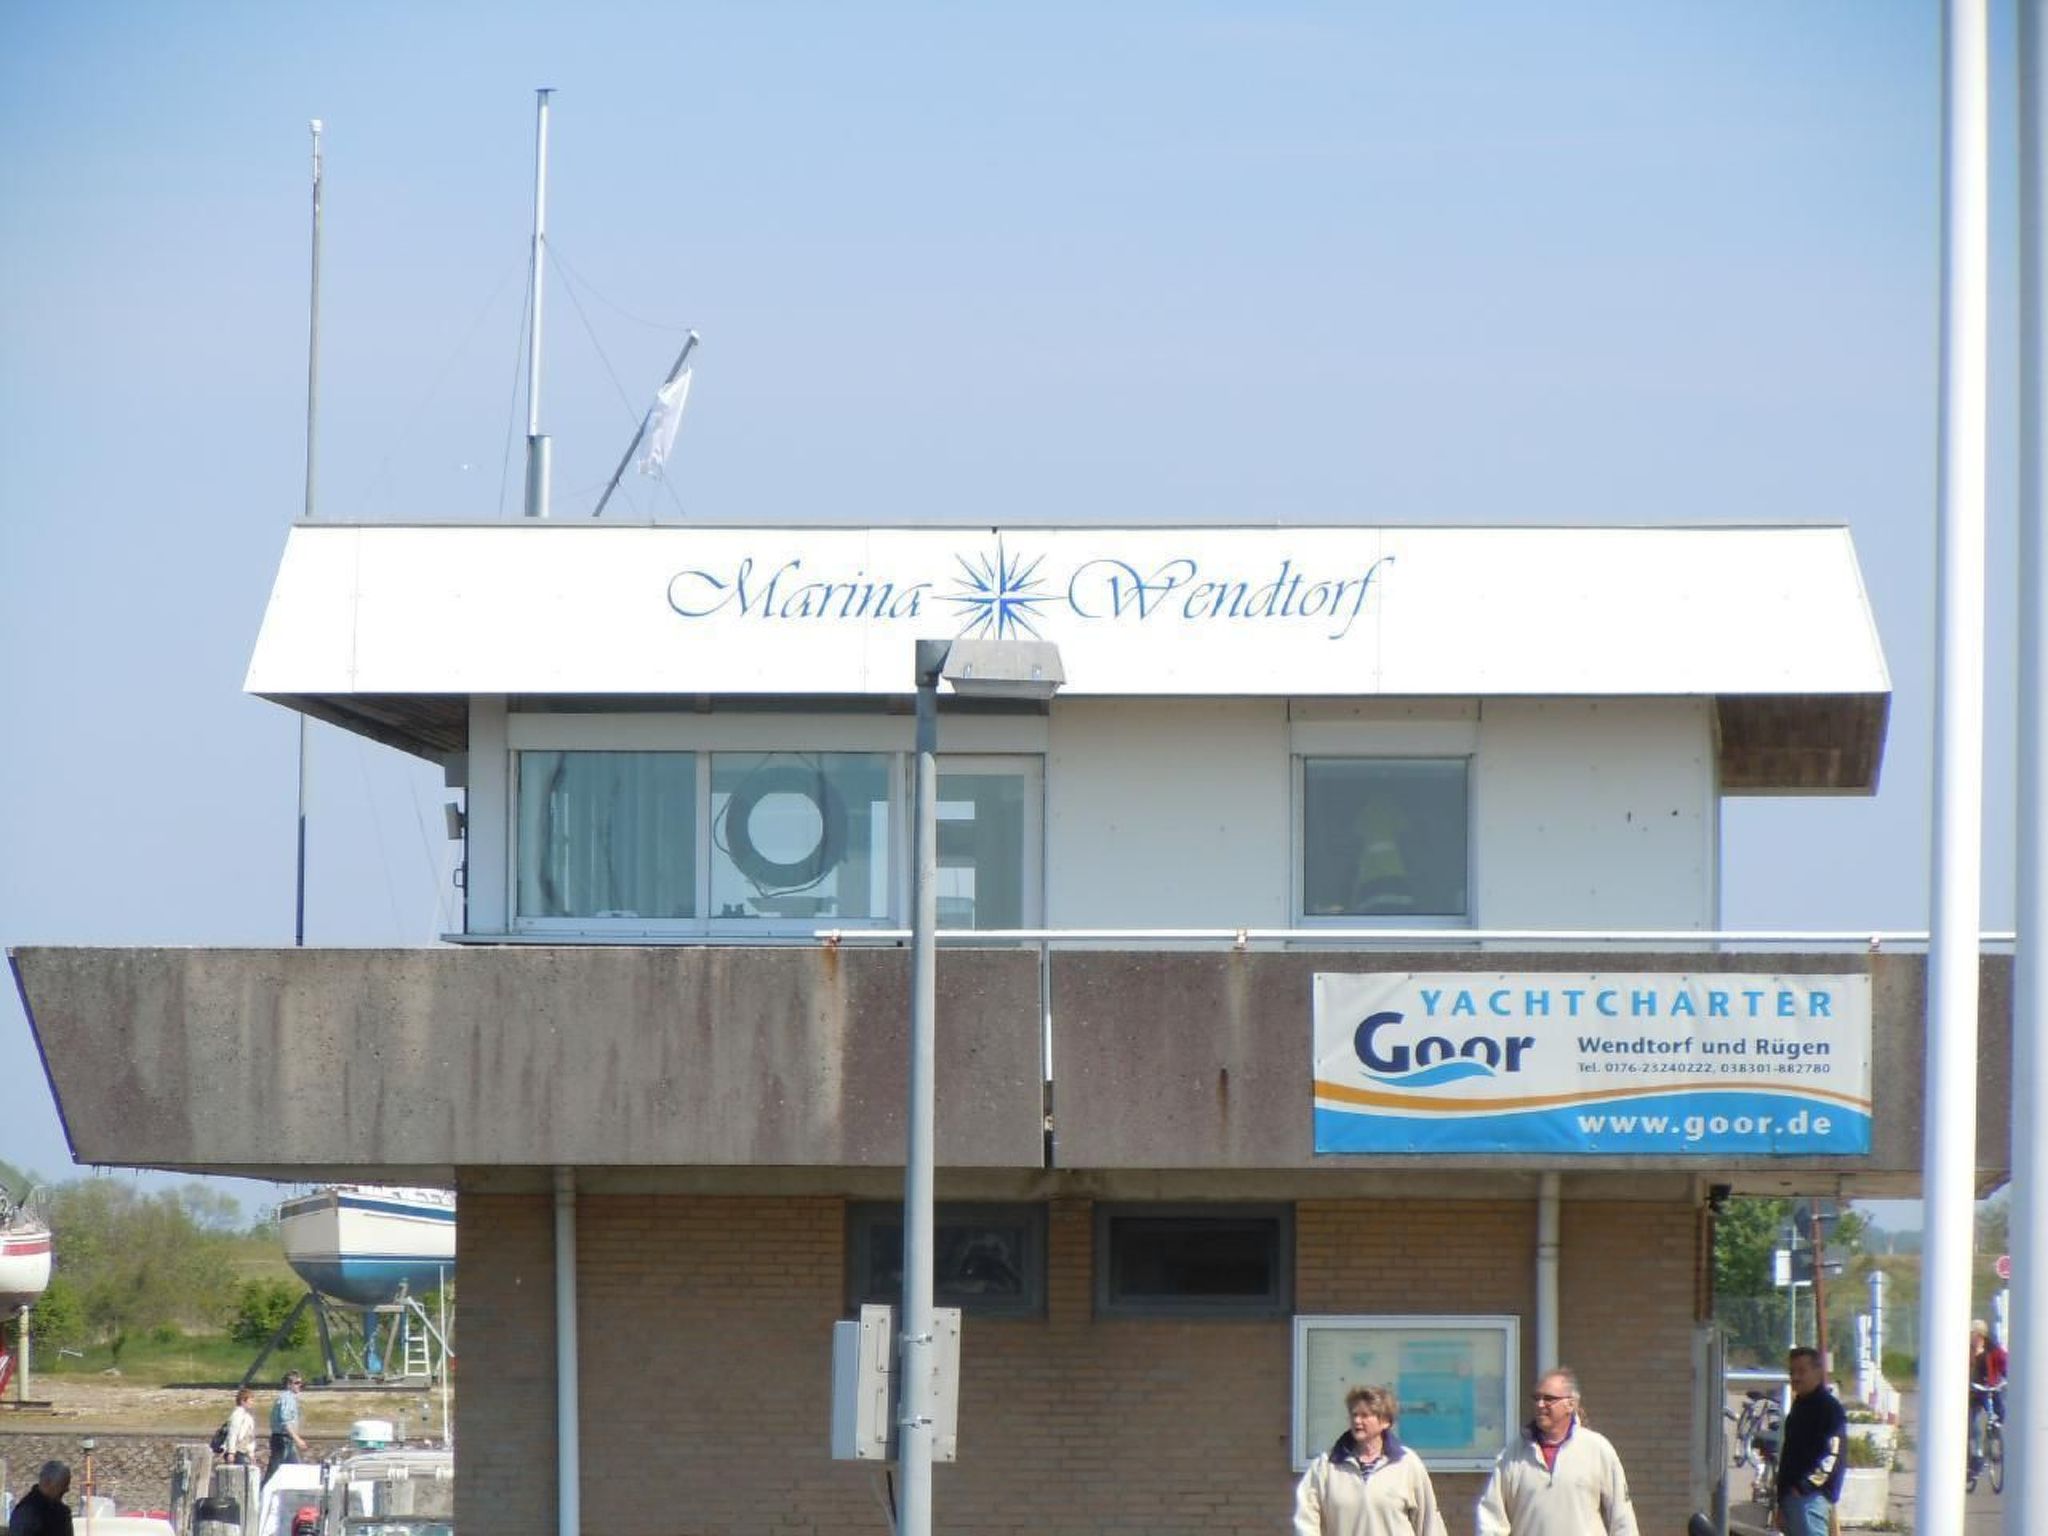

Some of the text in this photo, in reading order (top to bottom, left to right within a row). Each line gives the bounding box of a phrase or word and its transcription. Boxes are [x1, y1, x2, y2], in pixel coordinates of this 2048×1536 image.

[667, 556, 1396, 640] Marina Wendtorf
[1420, 990, 1833, 1017] YACHTCHARTER
[1354, 1011, 1536, 1073] Goor
[1577, 1036, 1831, 1060] Wendtorf und Rügen
[1578, 1062, 1600, 1073] Tel.
[1578, 1111, 1832, 1140] www.goor.de
